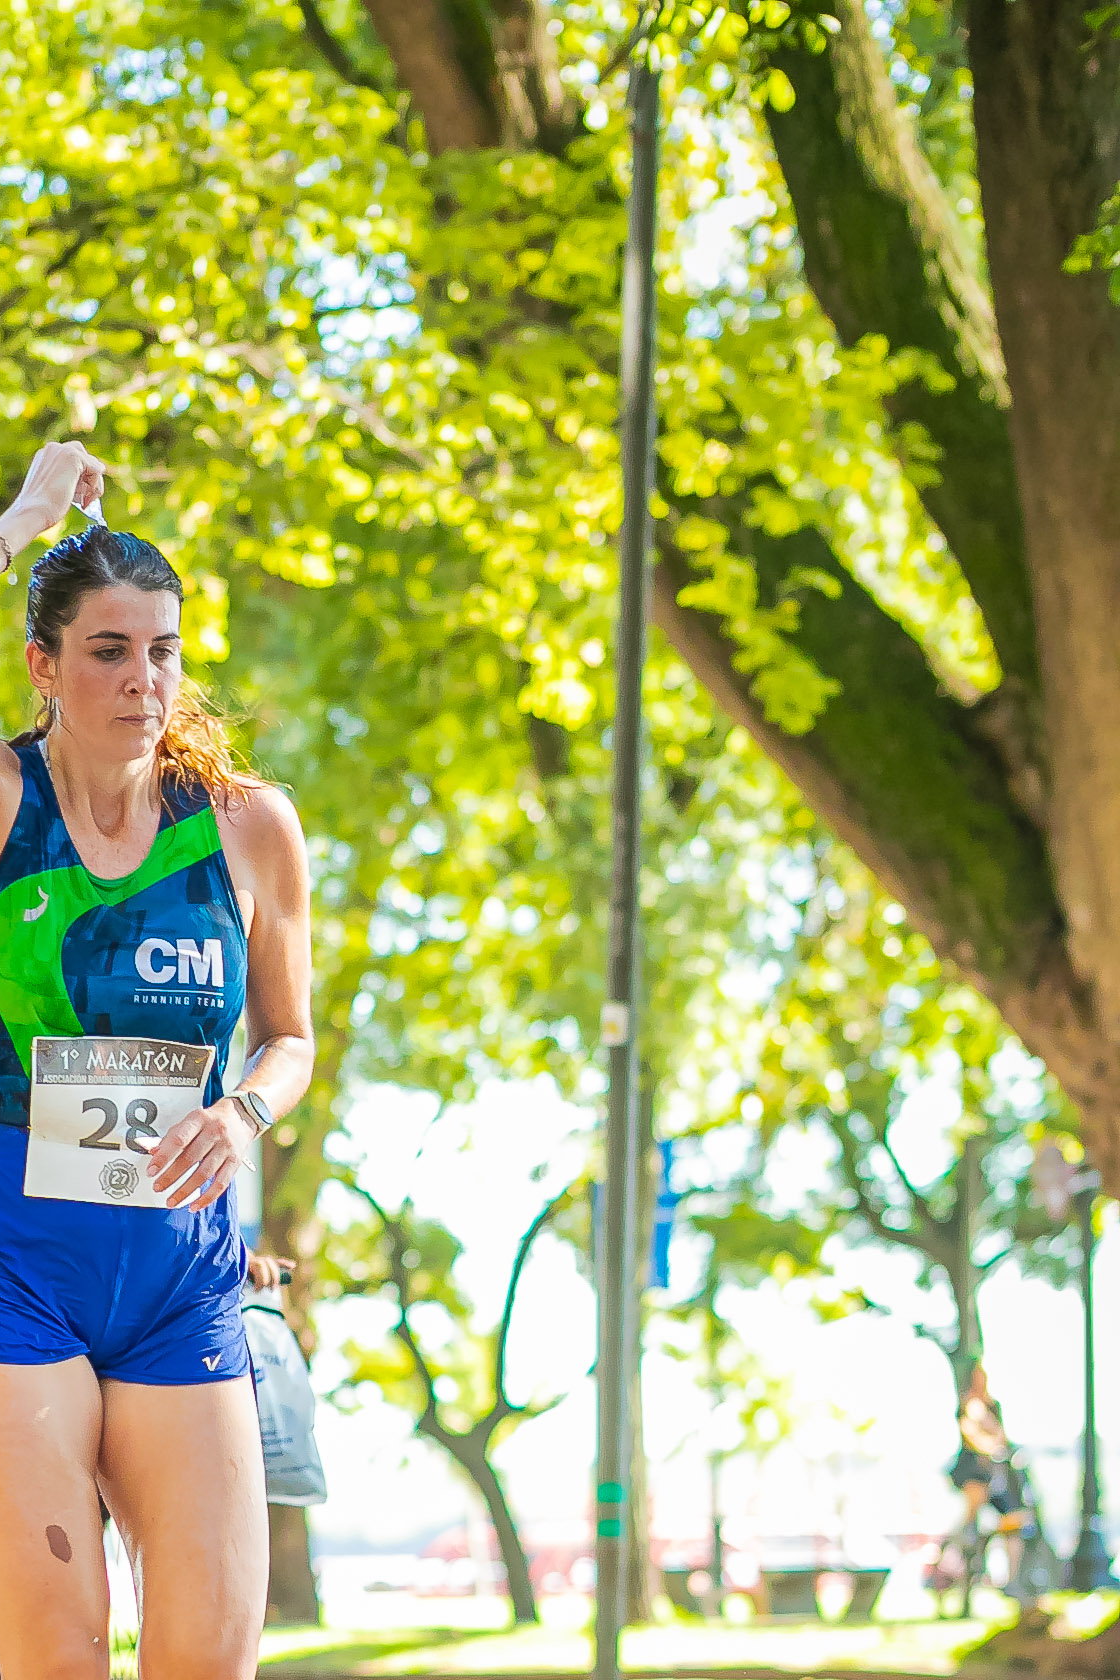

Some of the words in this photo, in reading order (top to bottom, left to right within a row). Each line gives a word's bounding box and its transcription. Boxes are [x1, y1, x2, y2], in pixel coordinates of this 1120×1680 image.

[134, 937, 225, 988] CM
[133, 994, 191, 1006] RUNNING
[196, 996, 226, 1009] TEAM
[85, 1046, 186, 1073] MARATÓN
[79, 1097, 159, 1154] 28
[110, 1170, 129, 1185] 27
